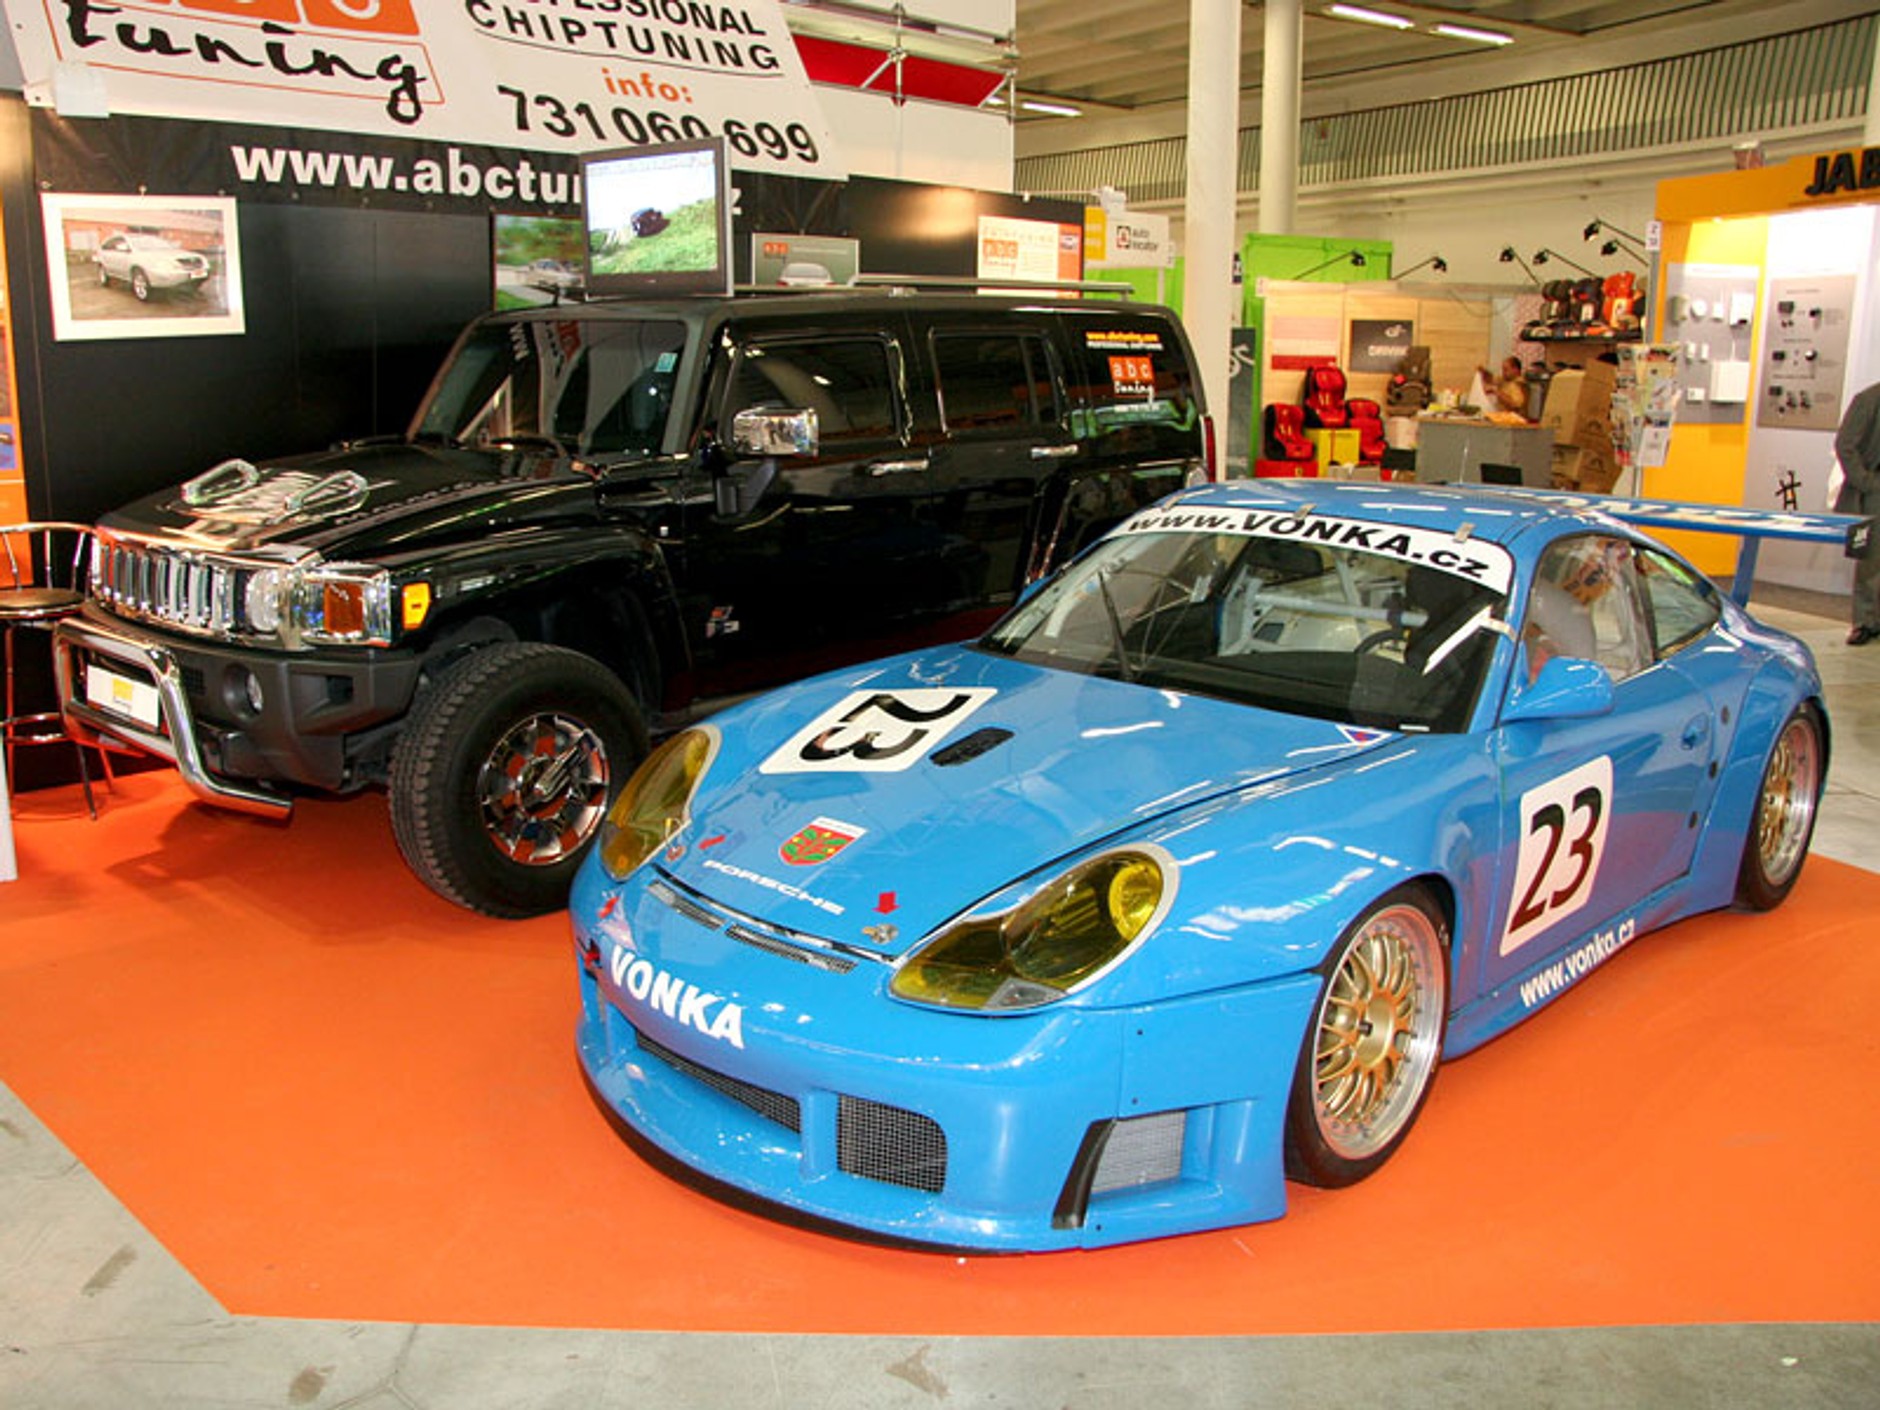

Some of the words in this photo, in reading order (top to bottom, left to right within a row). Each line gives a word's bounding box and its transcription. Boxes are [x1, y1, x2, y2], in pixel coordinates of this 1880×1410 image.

[62, 0, 427, 125] tuning
[466, 0, 780, 70] CHIPTUNING
[601, 66, 694, 104] info:
[1113, 360, 1151, 379] abc
[1130, 511, 1490, 579] www.VONKA.cz
[702, 859, 846, 916] PORSCHE
[1509, 786, 1603, 934] 23
[610, 945, 746, 1049] VONKA
[1519, 919, 1636, 1008] www.vonka.cz
